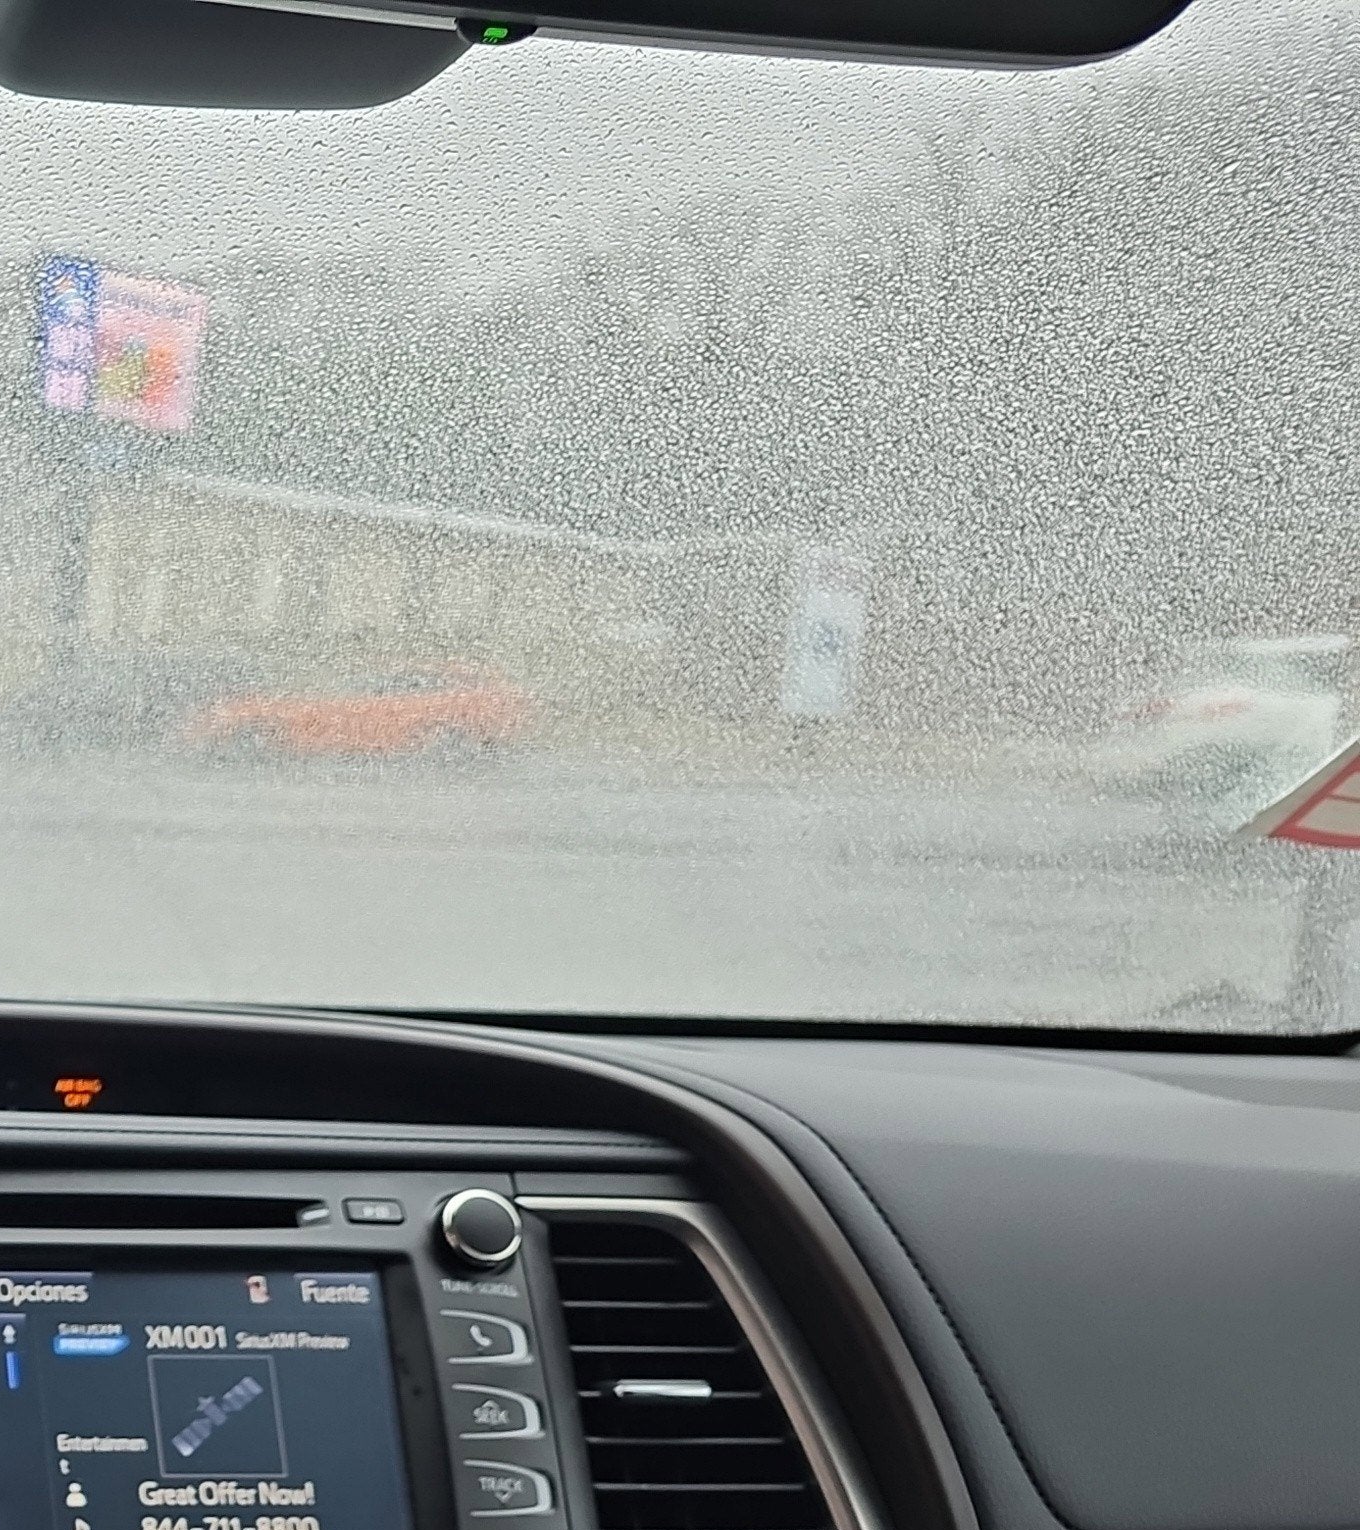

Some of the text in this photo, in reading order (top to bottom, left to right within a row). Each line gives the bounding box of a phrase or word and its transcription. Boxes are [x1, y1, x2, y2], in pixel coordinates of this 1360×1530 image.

[300, 1279, 371, 1303] Fuente
[145, 1325, 227, 1349] XM001
[138, 1481, 316, 1506] Great Offer Now!
